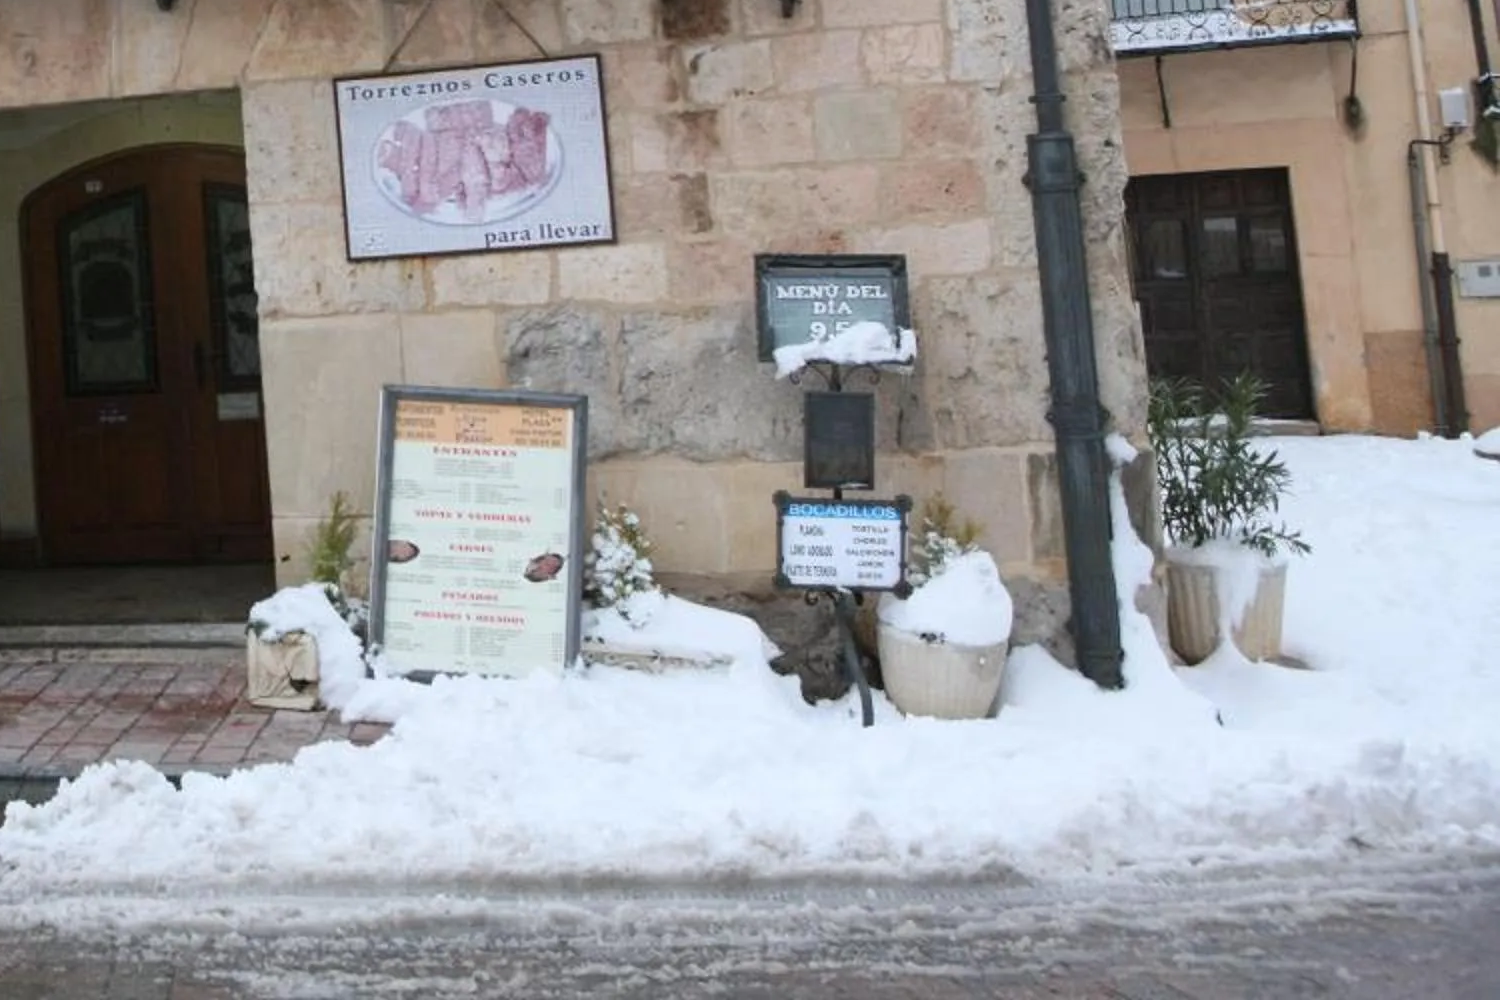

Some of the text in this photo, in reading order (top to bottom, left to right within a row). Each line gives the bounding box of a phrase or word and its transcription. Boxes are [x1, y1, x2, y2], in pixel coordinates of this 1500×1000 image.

[346, 68, 586, 101] Torreznos Caseros
[485, 222, 602, 248] para llevar
[846, 285, 888, 299] DEL
[789, 503, 897, 519] BOCADILLOS
